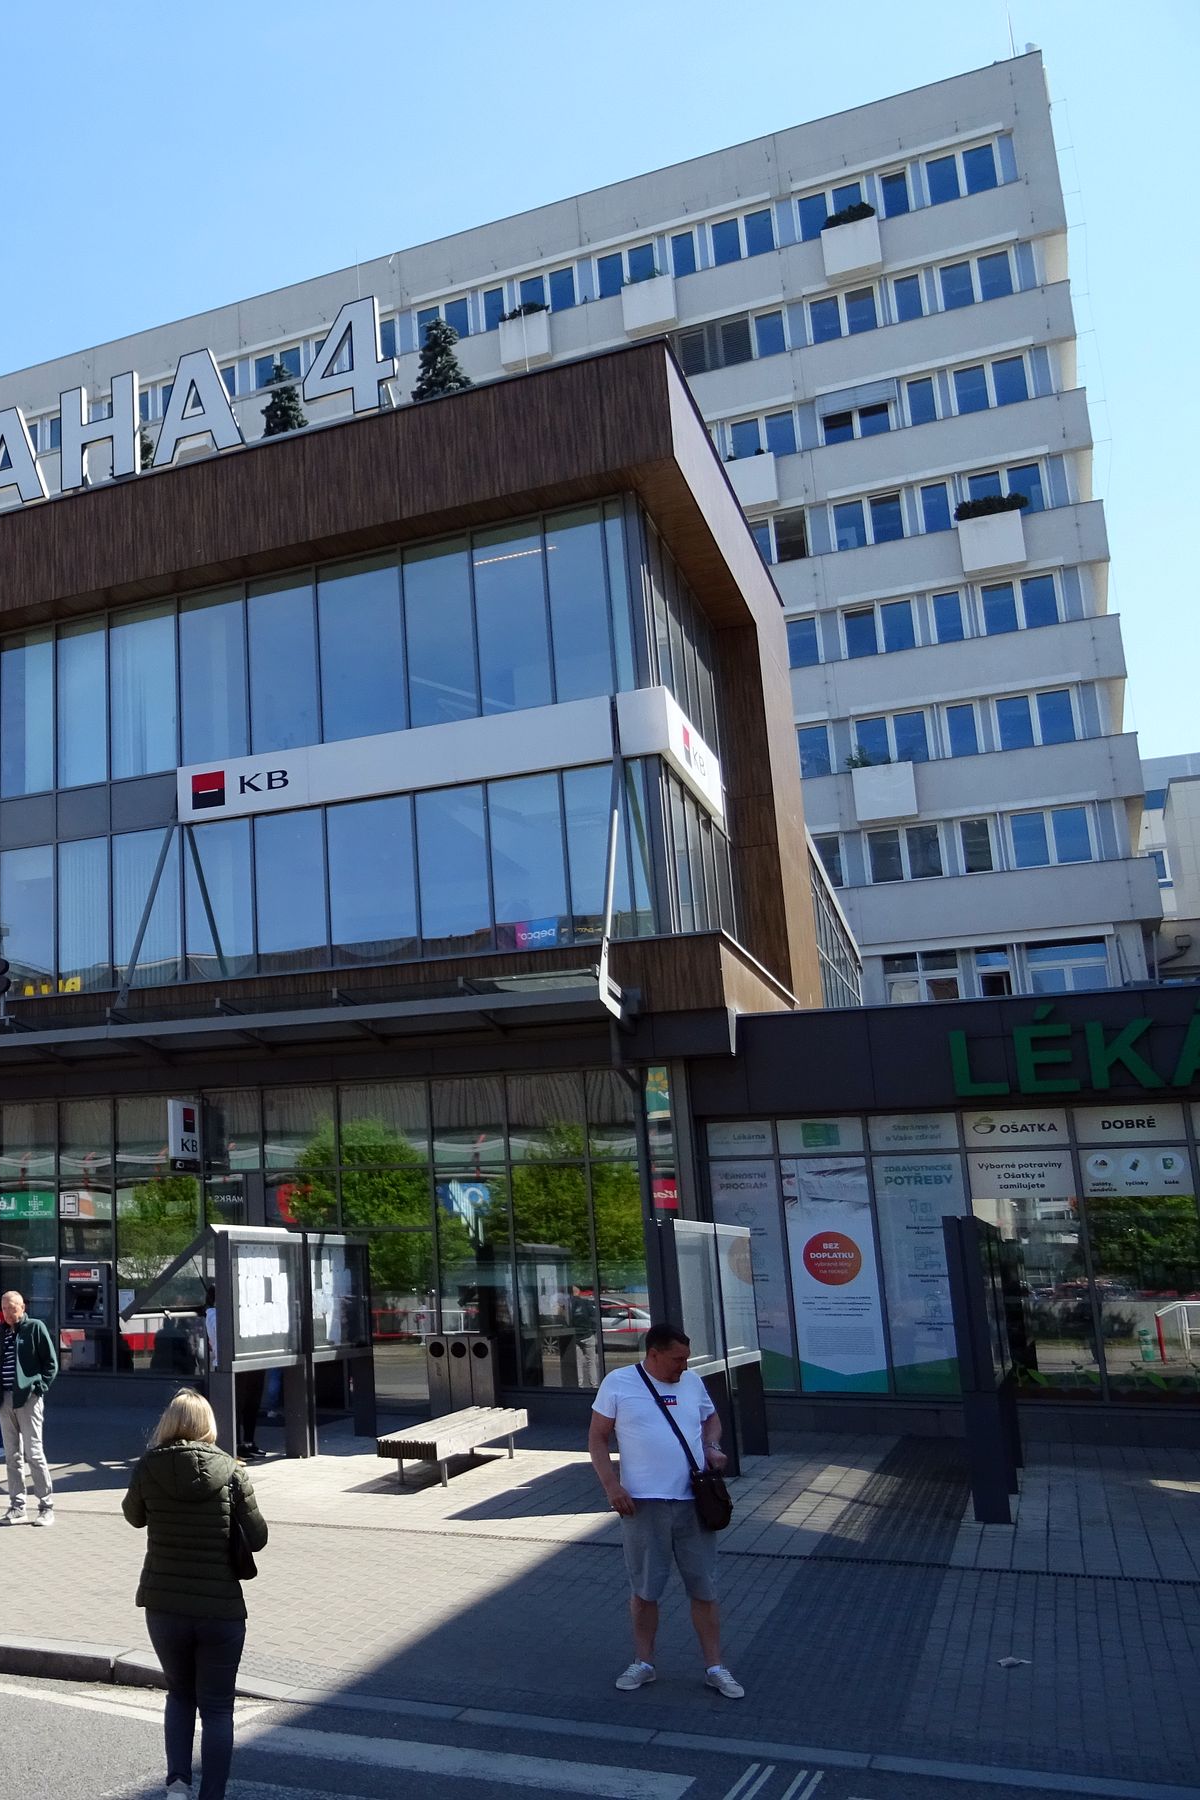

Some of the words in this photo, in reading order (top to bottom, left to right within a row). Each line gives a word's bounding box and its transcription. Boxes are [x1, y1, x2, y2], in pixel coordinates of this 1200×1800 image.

[302, 295, 398, 414] 4
[692, 746, 706, 777] KB
[238, 769, 289, 795] KB
[999, 1120, 1058, 1134] OŠATKA
[1100, 1115, 1157, 1130] DOBRÉ
[181, 1138, 198, 1153] KB
[1018, 1160, 1062, 1170] potraviny
[884, 1172, 953, 1186] POTŘEBY
[1003, 1171, 1036, 1180] Ošatky
[1000, 1182, 1046, 1191] zamilujete
